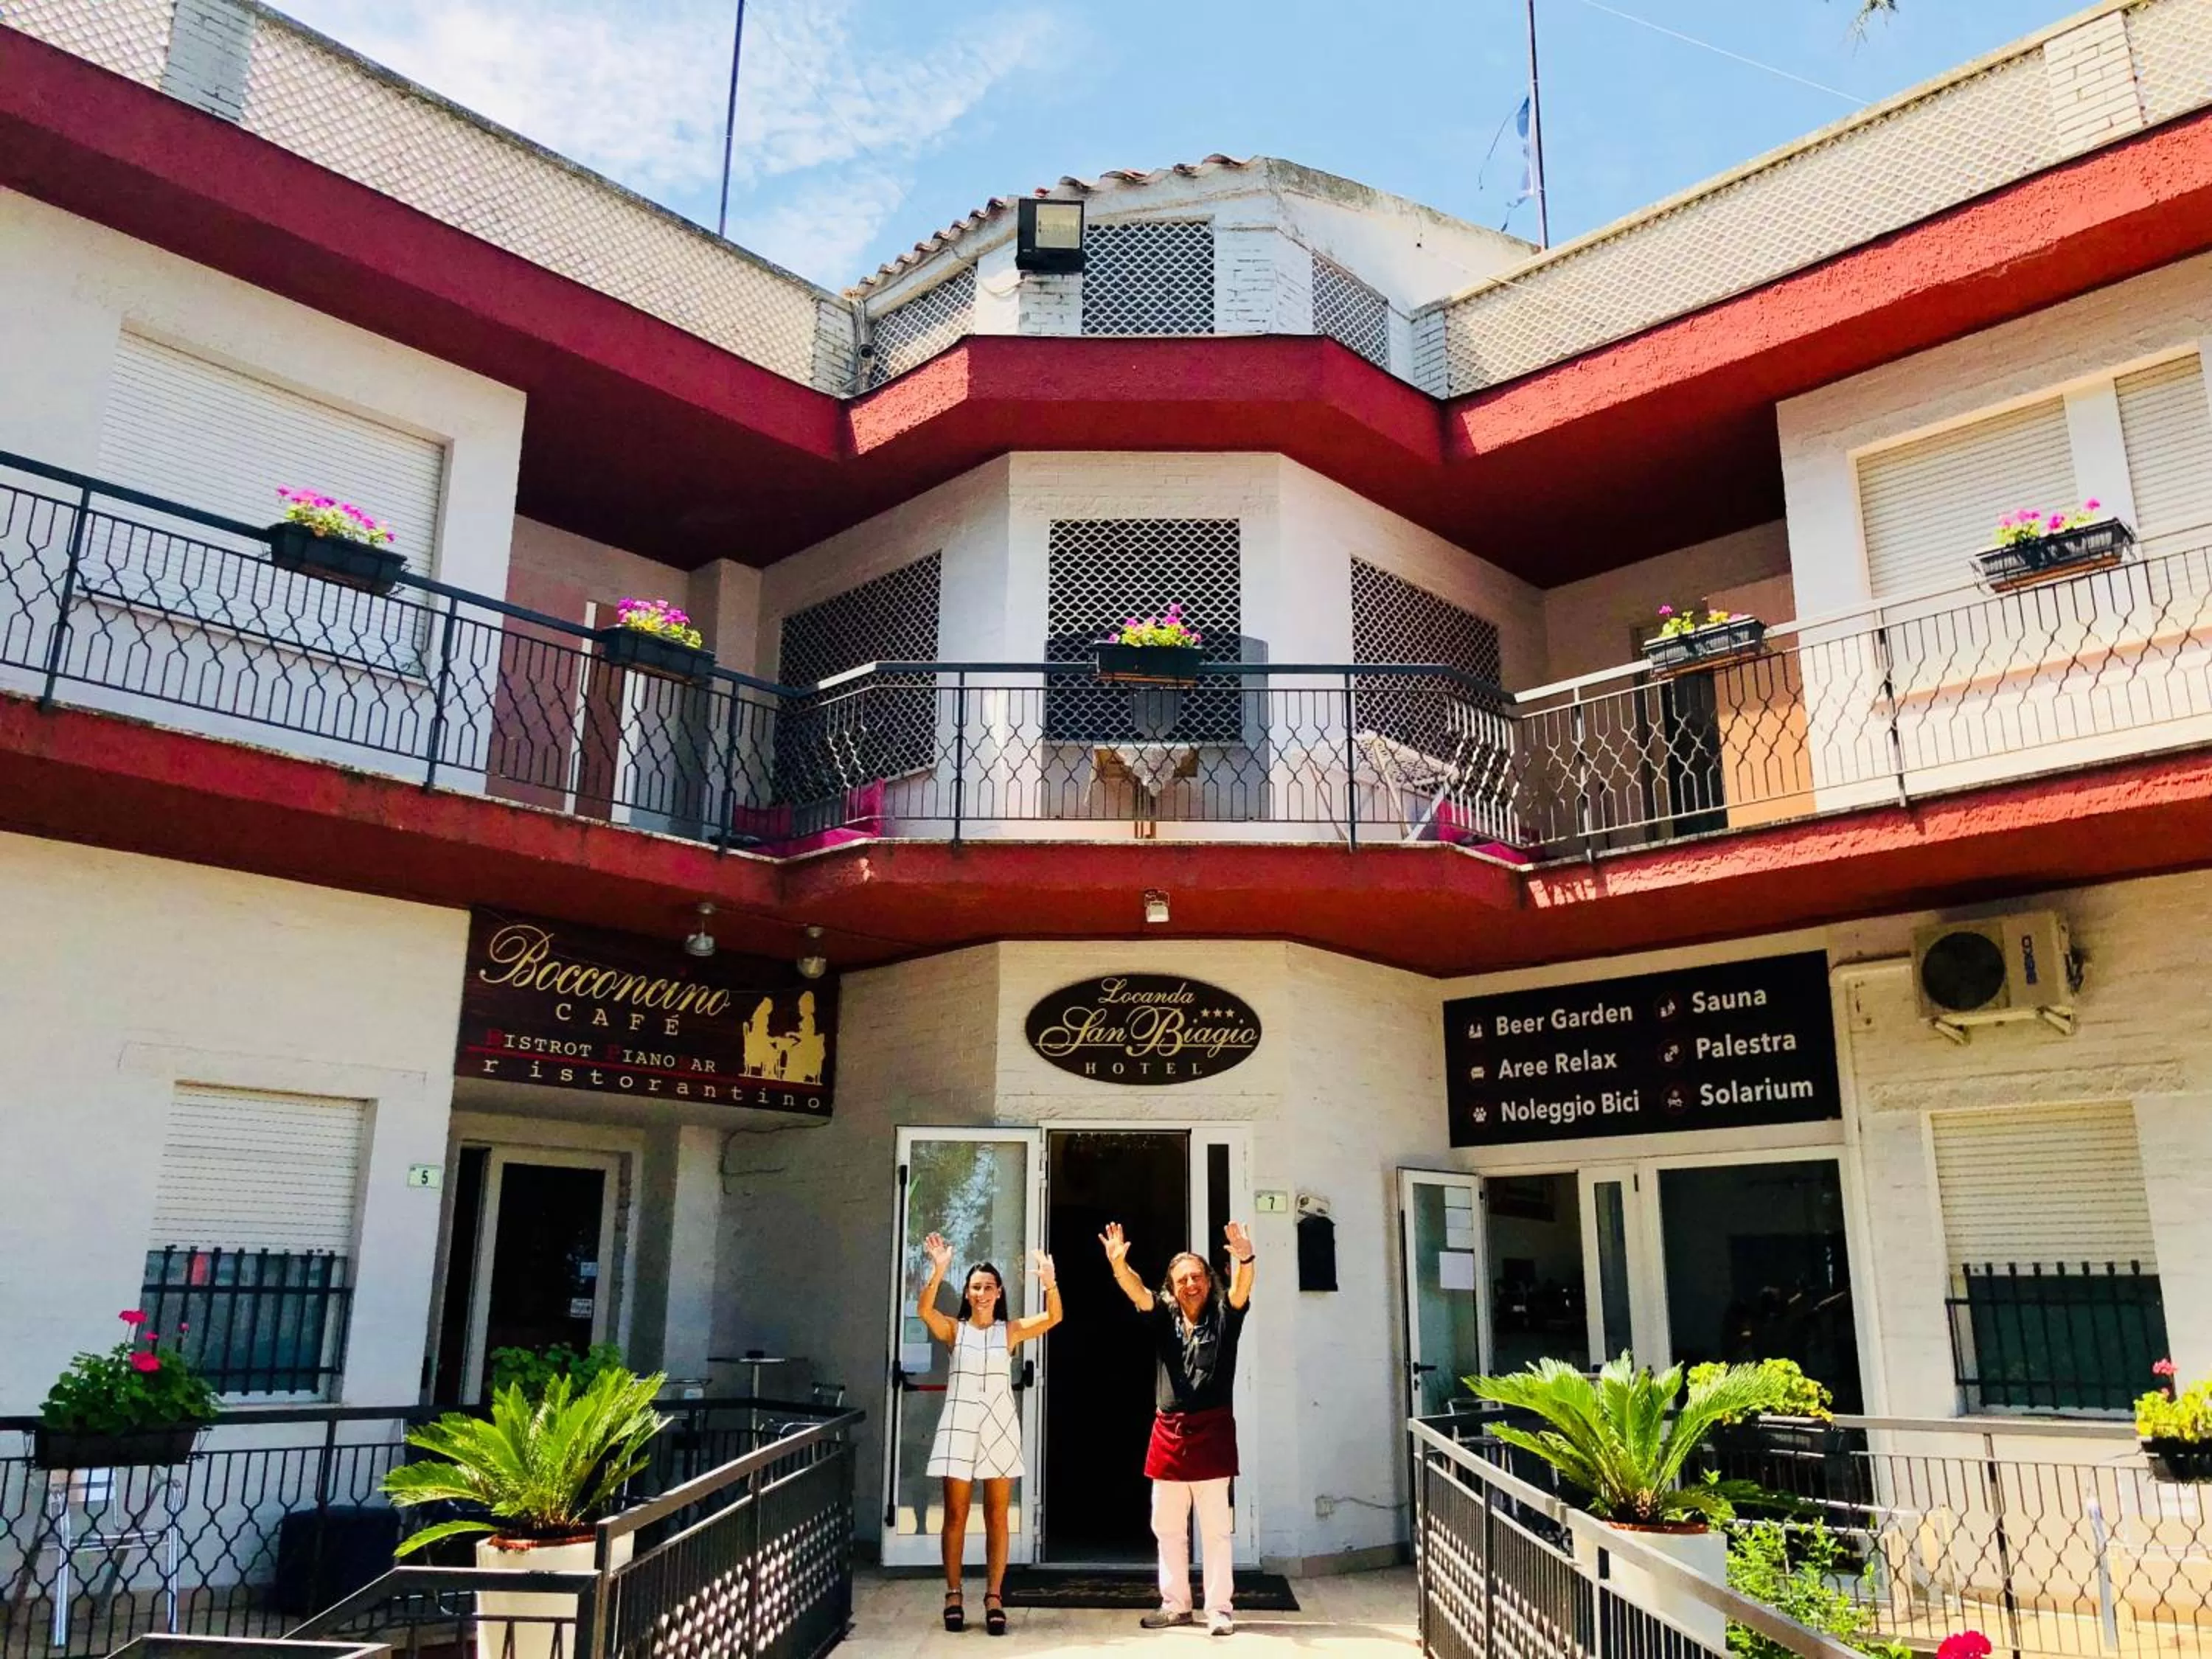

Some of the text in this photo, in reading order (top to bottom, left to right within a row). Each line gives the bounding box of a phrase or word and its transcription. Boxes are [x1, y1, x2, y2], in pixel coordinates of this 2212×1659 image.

[479, 925, 731, 1016] Bocconcino
[1097, 977, 1195, 1004] Locanda
[1691, 988, 1767, 1014] Sauna
[554, 1003, 680, 1036] CAFÉ
[1039, 1005, 1257, 1058] San Biagio
[1495, 1003, 1634, 1036] Beer Garden
[1696, 1033, 1797, 1060] Palestra
[1085, 1062, 1203, 1075] HOTEL
[1498, 1049, 1618, 1080] Aree Relax
[483, 1057, 820, 1109] ristorantino
[1700, 1077, 1814, 1107] Solarium
[1500, 1090, 1641, 1124] Noleggio Bici
[421, 1169, 428, 1185] 5
[1268, 1196, 1275, 1210] 7
